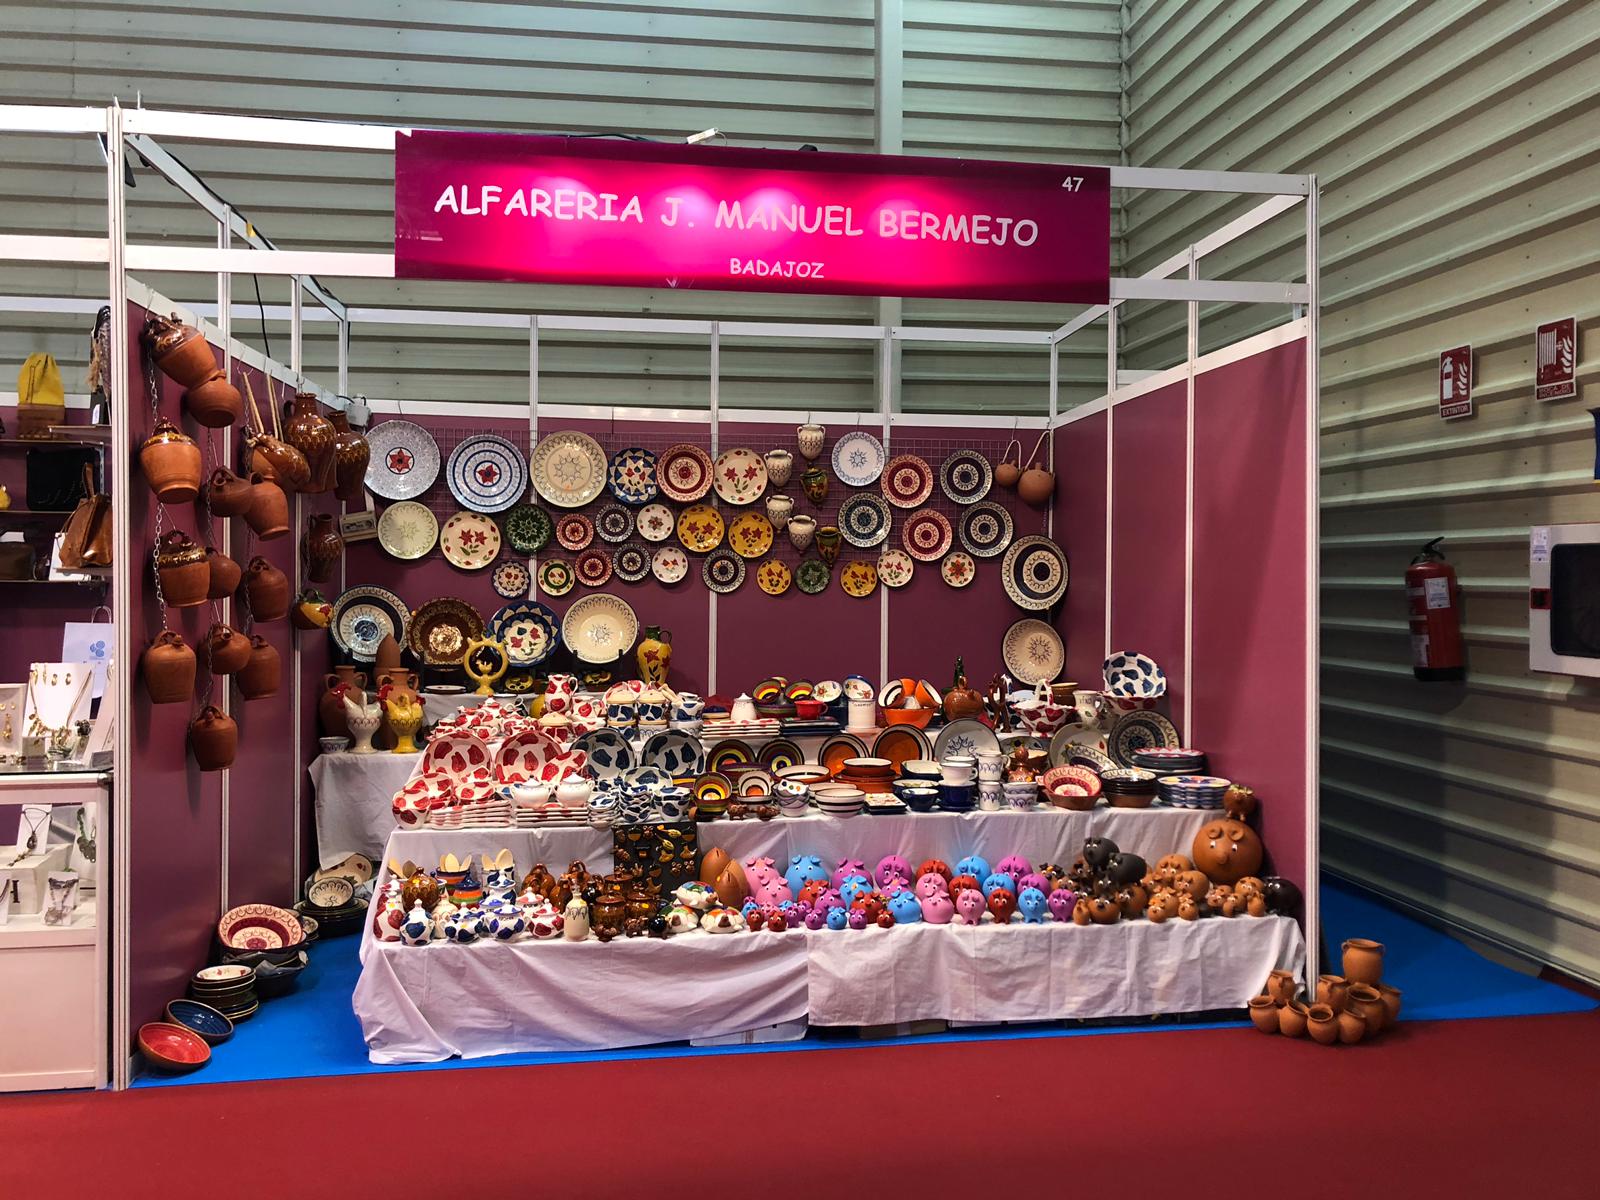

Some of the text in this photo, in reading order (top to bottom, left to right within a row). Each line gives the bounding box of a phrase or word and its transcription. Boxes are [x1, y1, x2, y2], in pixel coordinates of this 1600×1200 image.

[1062, 176, 1084, 192] 47
[434, 184, 1038, 246] ALFARERIA J. MANUEL BERMEJO
[730, 258, 824, 278] BADAJOZ
